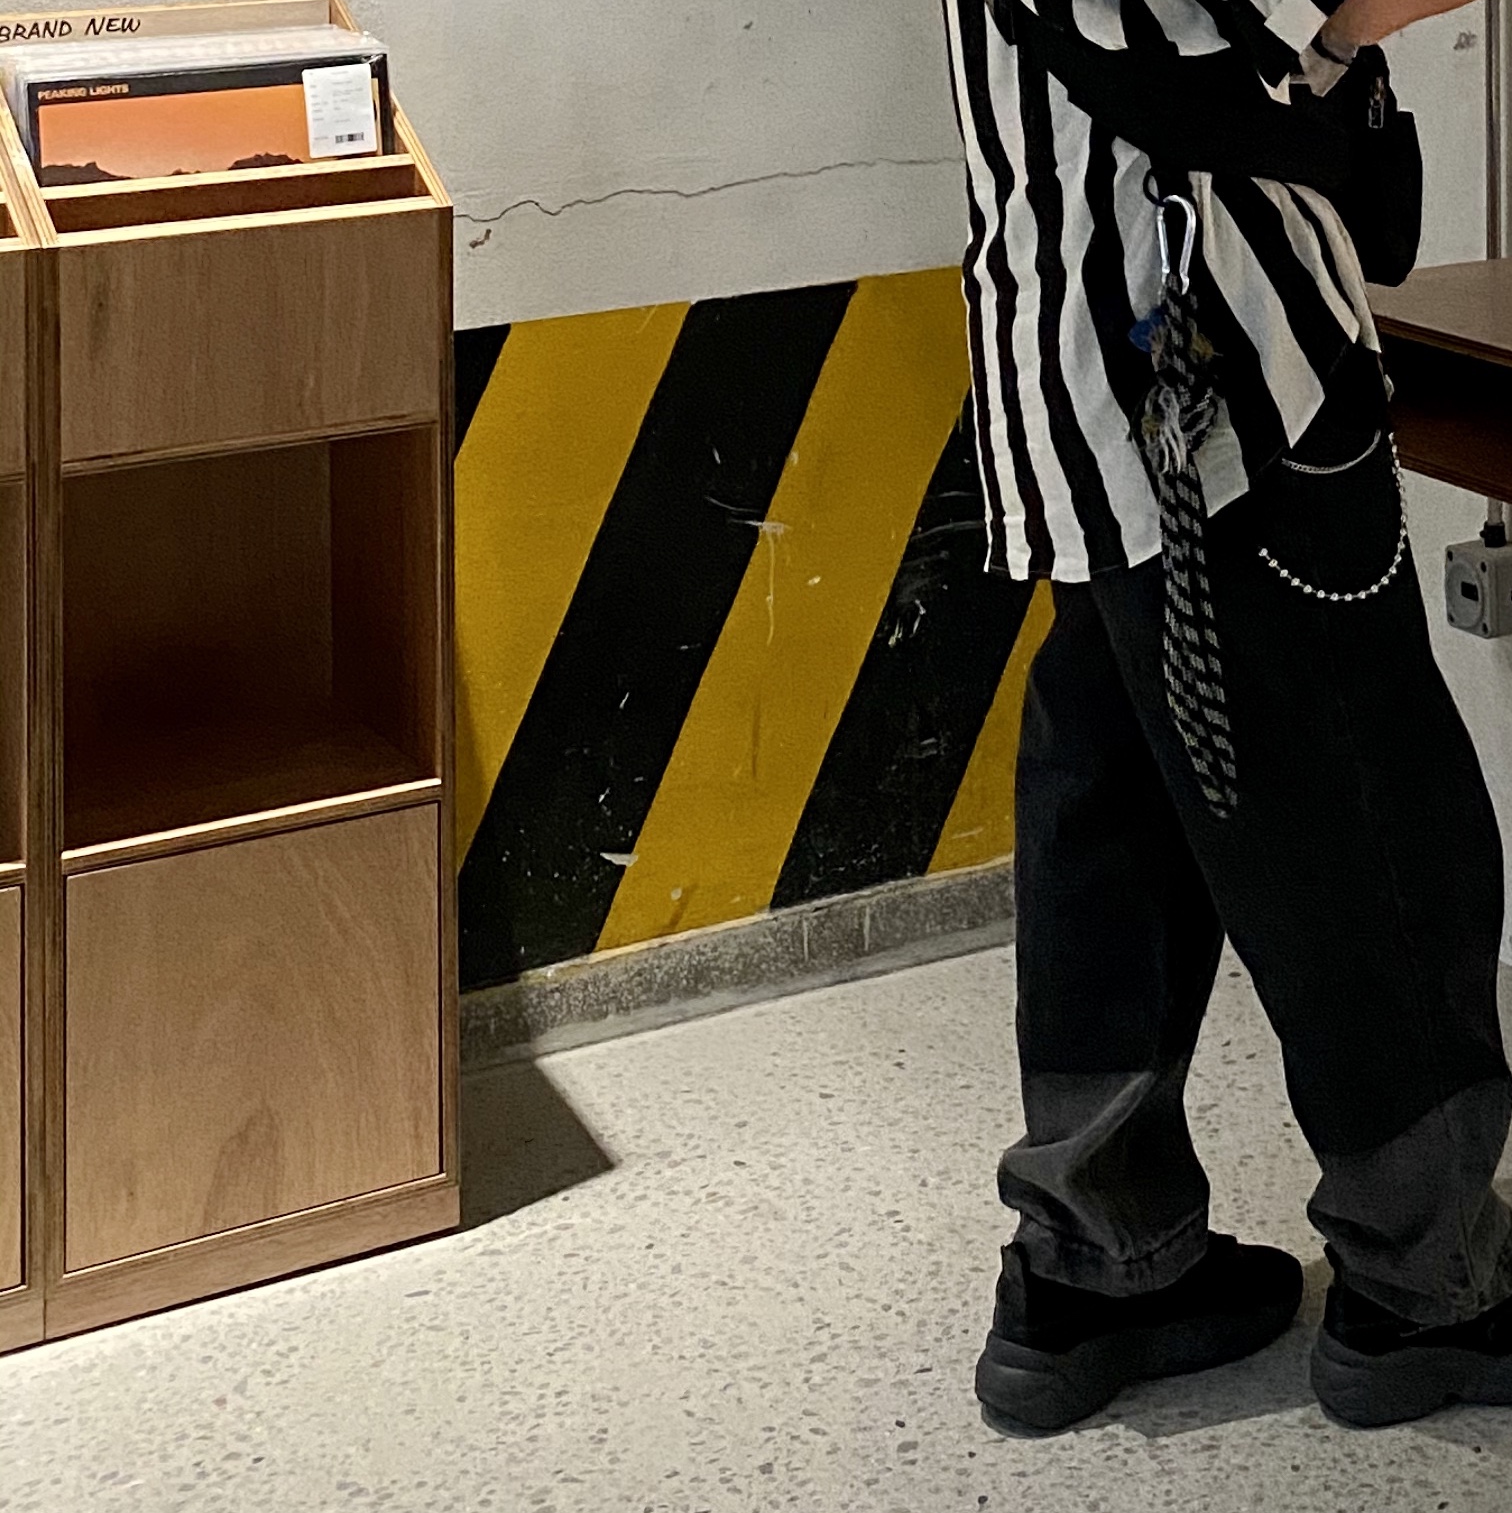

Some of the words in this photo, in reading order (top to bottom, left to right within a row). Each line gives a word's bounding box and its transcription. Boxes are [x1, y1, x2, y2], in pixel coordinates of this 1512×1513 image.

[0, 20, 72, 43] BRAND
[84, 17, 141, 36] NEW
[38, 87, 87, 100] PEAKING
[89, 83, 130, 96] LIGHTS
